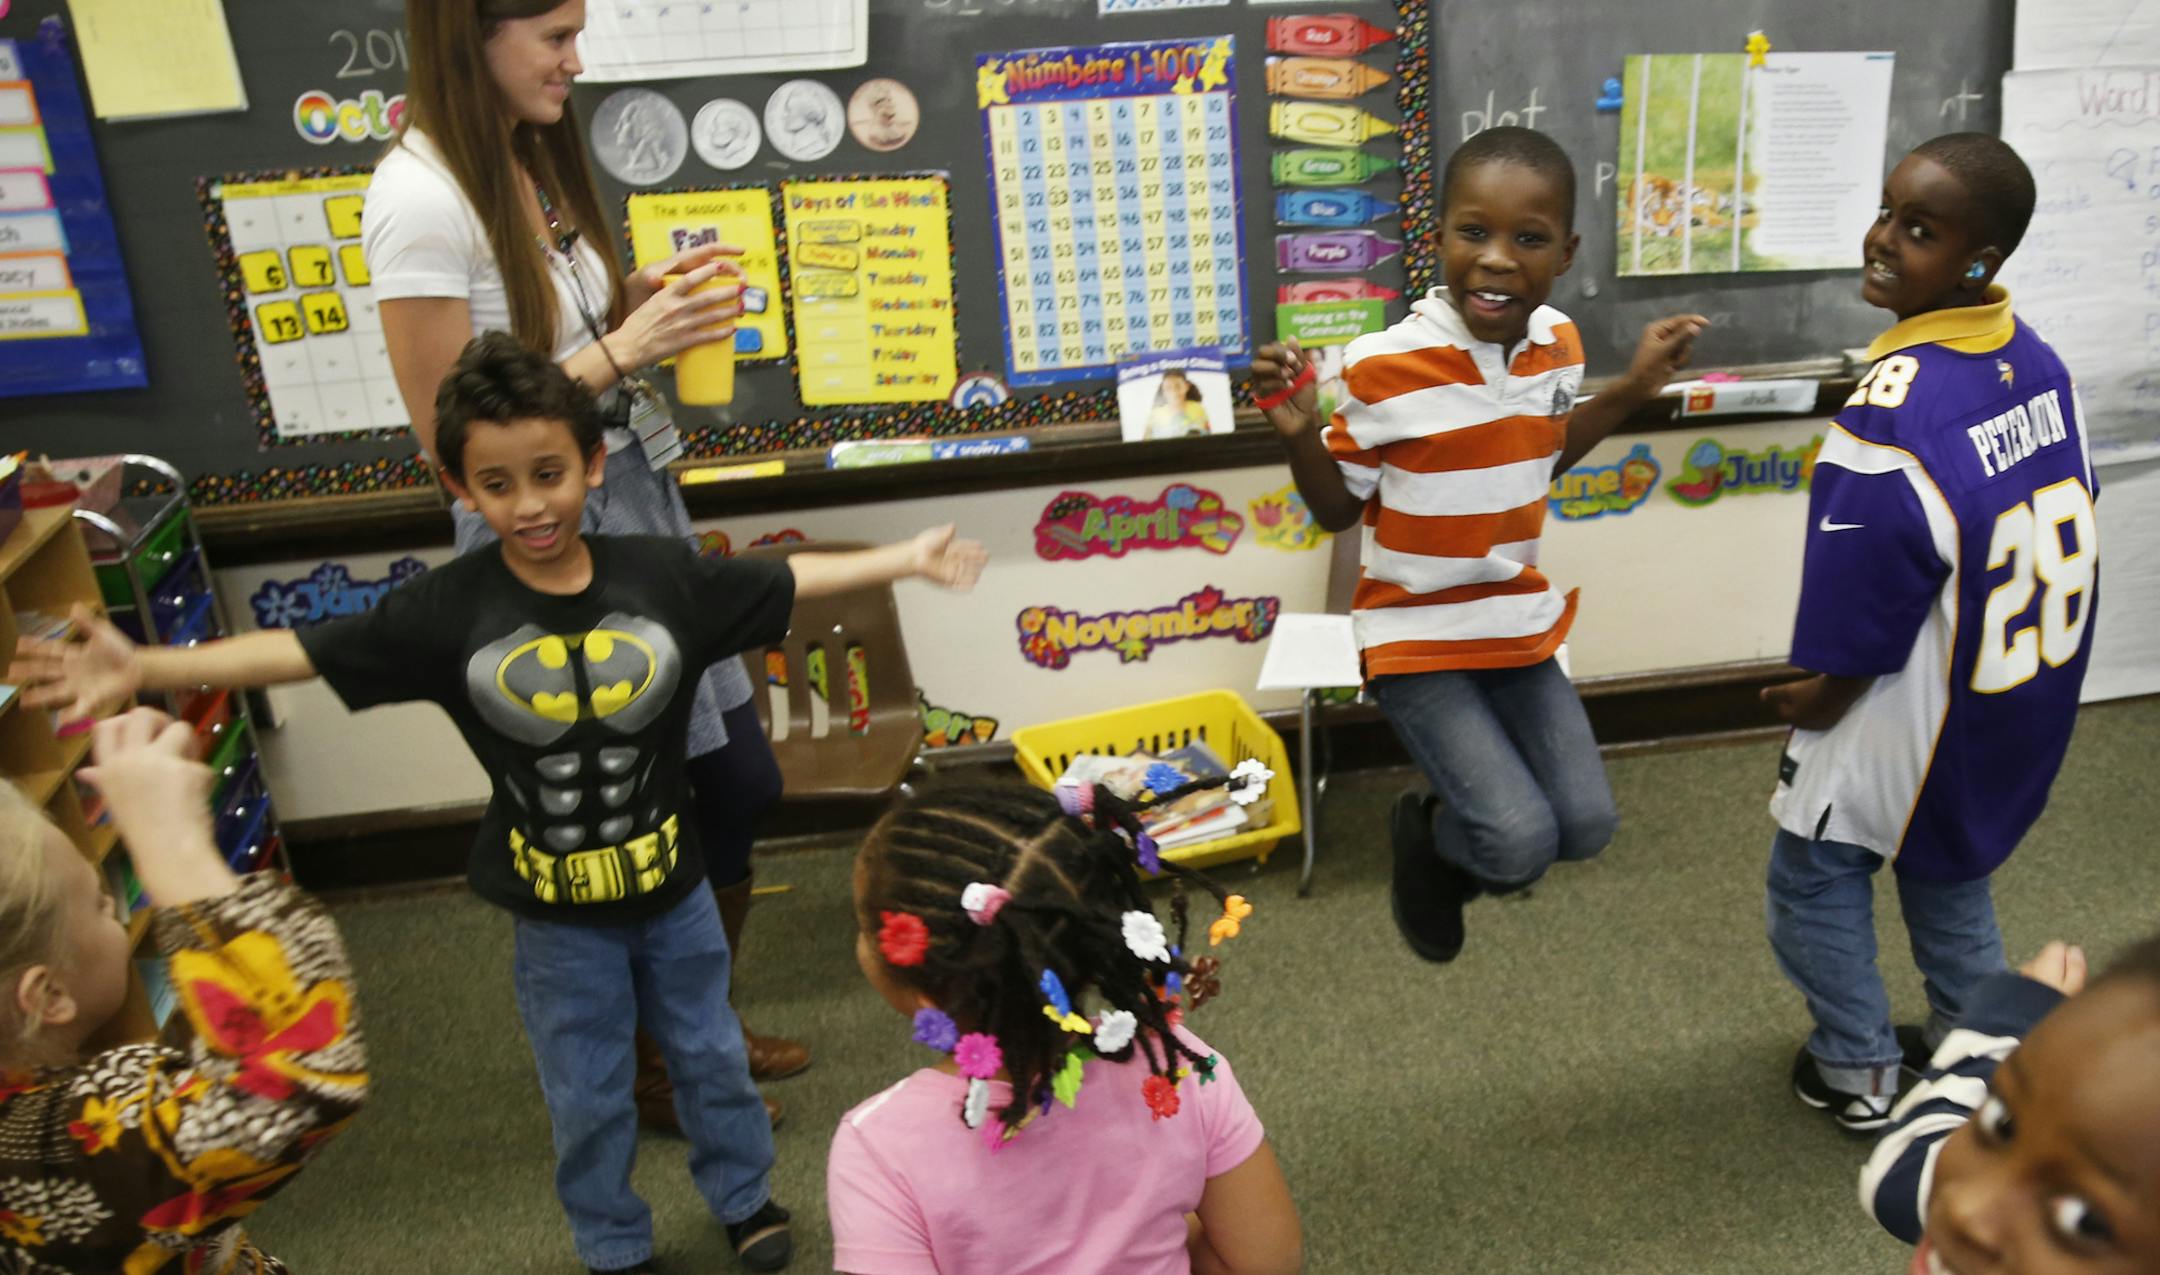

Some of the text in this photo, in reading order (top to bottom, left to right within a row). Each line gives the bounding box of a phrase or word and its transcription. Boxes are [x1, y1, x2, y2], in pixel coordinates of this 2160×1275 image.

[1305, 27, 1332, 43] Red
[328, 29, 409, 78] 201
[1004, 47, 1200, 94] Numbers 1-100
[1209, 99, 1222, 112] 10
[2077, 72, 2149, 116] Word
[296, 92, 408, 141] Oct
[1023, 139, 1036, 152] 12
[1048, 137, 1061, 151] 13
[1070, 136, 1084, 148] 14
[1095, 134, 1107, 147] 15
[1117, 134, 1131, 146] 16
[1142, 130, 1154, 144] 17
[1165, 129, 1177, 143] 18
[1188, 128, 1201, 140] 19
[1208, 126, 1227, 140] 20
[1003, 152, 1228, 181] 21 22 23 24 25 26 27 28 29 30
[1302, 160, 1341, 172] Green
[790, 190, 939, 212] Days of the Week
[1006, 195, 1018, 208] 31
[1027, 192, 1043, 206] 32
[1073, 190, 1091, 203] 34
[1098, 187, 1114, 201] 35
[1120, 186, 1138, 200] 36
[1144, 184, 1160, 198] 37
[1167, 183, 1183, 196] 38
[1190, 181, 1207, 195] 39
[1211, 179, 1230, 192] 40
[653, 204, 678, 216] The
[685, 203, 730, 216] season
[1008, 206, 1232, 235] 41 42 43 44 45 46 47 48 49 50
[1310, 202, 1336, 216] Blue
[672, 227, 717, 252] Fall
[865, 223, 915, 237] Sunday
[866, 246, 925, 261] Monday
[1010, 231, 1233, 261] 51 52 53 54 55 56 57 58 59 60
[1308, 244, 1347, 260] Purple
[267, 261, 328, 285] 6 7
[868, 272, 928, 286] Tuesday
[1013, 257, 1234, 287] 61 62 63 64 65 66 67 68 69 70
[871, 297, 947, 311] Wednesday
[1015, 283, 1236, 312] 71 72 73 74 75 76 77 78 79 80
[271, 307, 342, 337] 13 14
[872, 322, 937, 337] Thursday
[1018, 309, 1238, 339] 81 82 83 84 85 86 87 88 89 90
[873, 348, 917, 362] Friday
[876, 371, 939, 386] Saturday
[1549, 469, 1619, 499] une
[1723, 451, 1799, 490] July
[1081, 506, 1180, 551] April
[1970, 476, 2099, 694] 28
[295, 580, 402, 621] Jan
[1045, 600, 1254, 650] November
